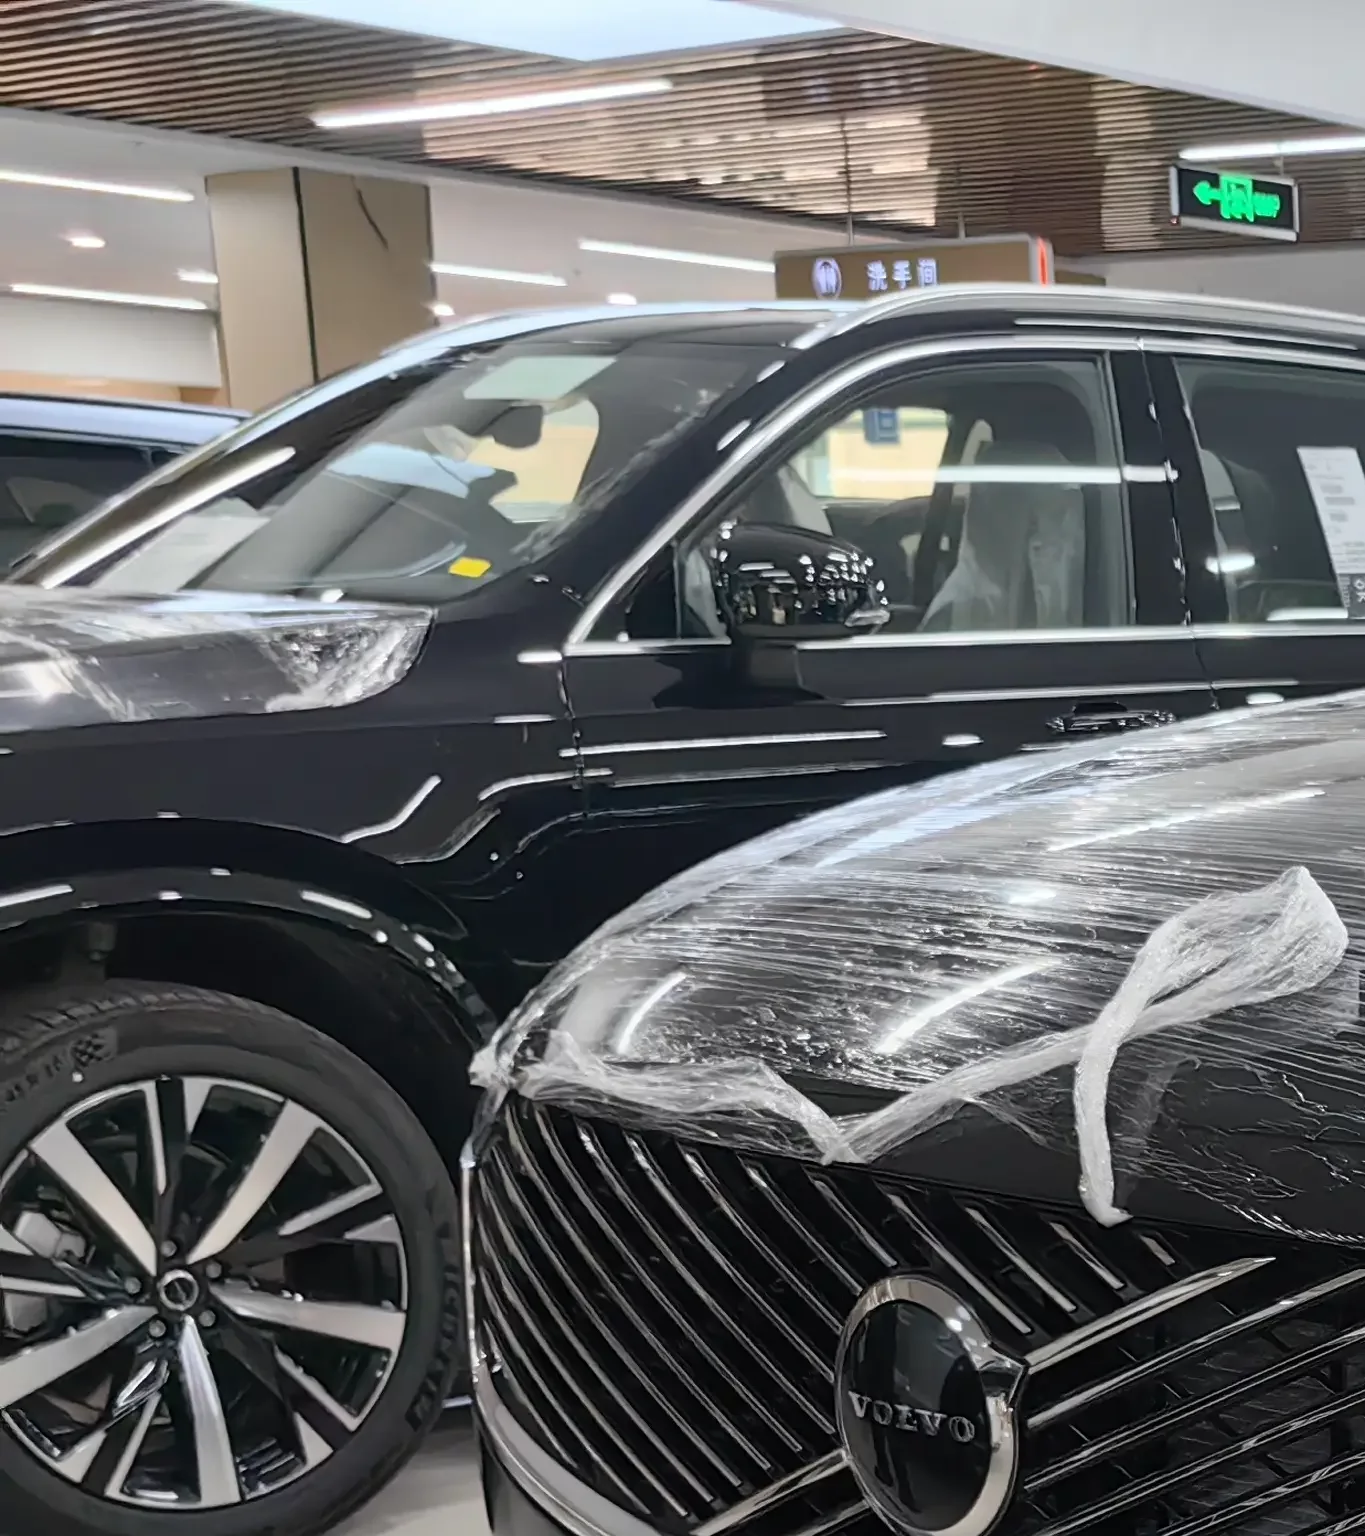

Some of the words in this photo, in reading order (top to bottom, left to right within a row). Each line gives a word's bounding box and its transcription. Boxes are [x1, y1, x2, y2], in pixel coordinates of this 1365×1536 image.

[866, 257, 938, 292] 洗手间
[847, 1390, 976, 1443] VOLVO
